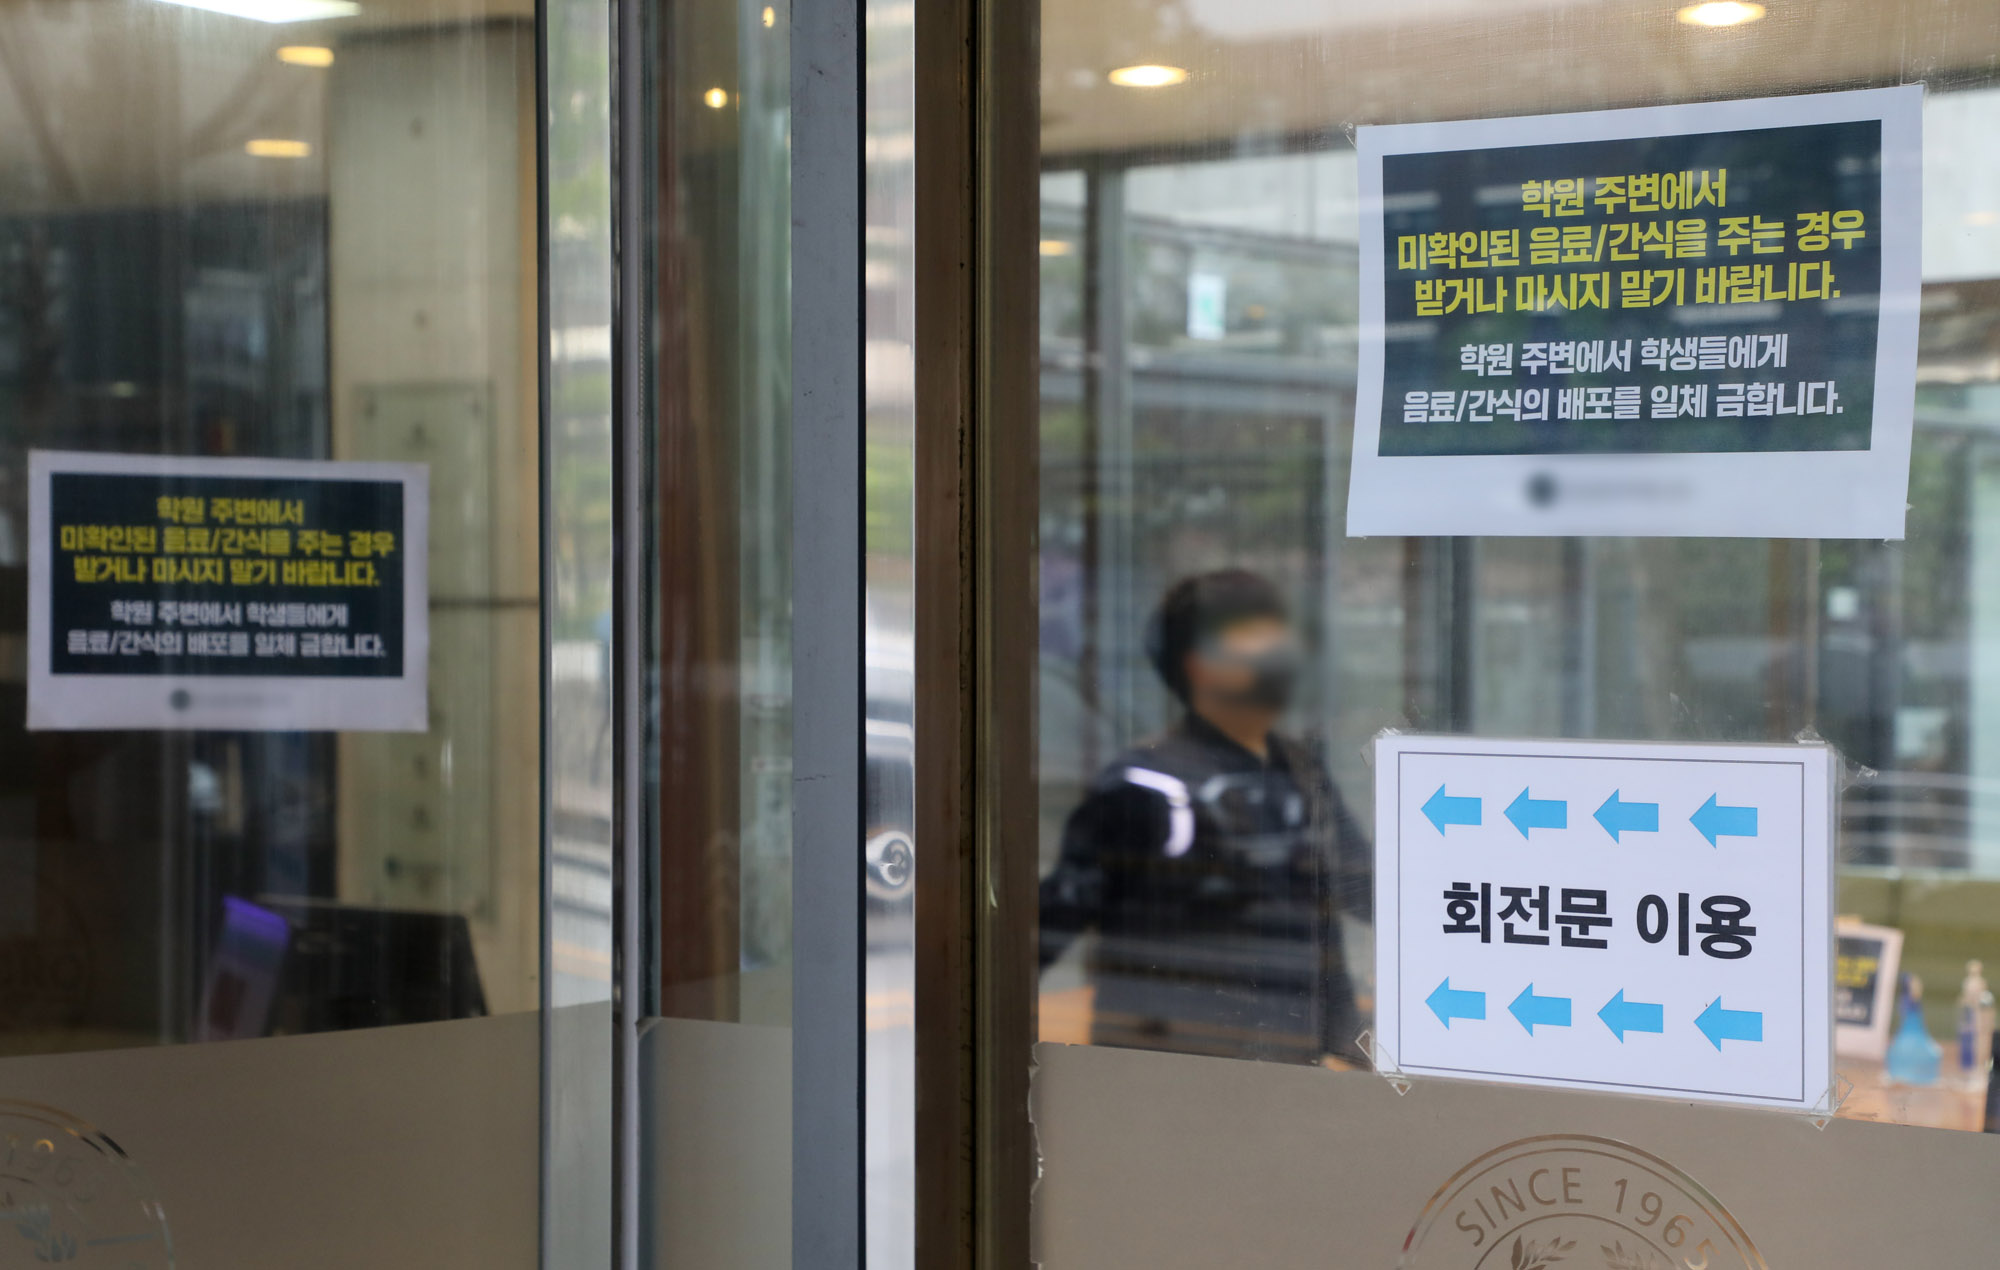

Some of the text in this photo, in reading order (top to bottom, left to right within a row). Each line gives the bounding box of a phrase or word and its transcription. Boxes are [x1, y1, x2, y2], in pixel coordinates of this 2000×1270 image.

[1521, 169, 1727, 218] 학원 주변에서
[1398, 209, 1865, 270] 미확인된 음료/간식을 주는 경우
[1415, 260, 1841, 316] 받거나 마시지 말기 바랍니다.
[1460, 334, 1788, 376] 학원 주변에서 학생들에게
[1403, 381, 1843, 424] 음료/간식의 배포를 일체 금합니다.
[157, 495, 304, 524] 학원 주변에서
[60, 526, 394, 557] 미확인된 음료/간식을 주는 경우
[74, 556, 380, 586] 받거나 마시지 말기 바랍니다.
[110, 600, 348, 627] 학원 주변에서 학생들에게
[68, 630, 386, 658] 음료/간식의 배포를 일체 금합니다.
[1442, 882, 1757, 960] 회전문 이용
[1456, 1167, 1720, 1270] SINCE 1965
